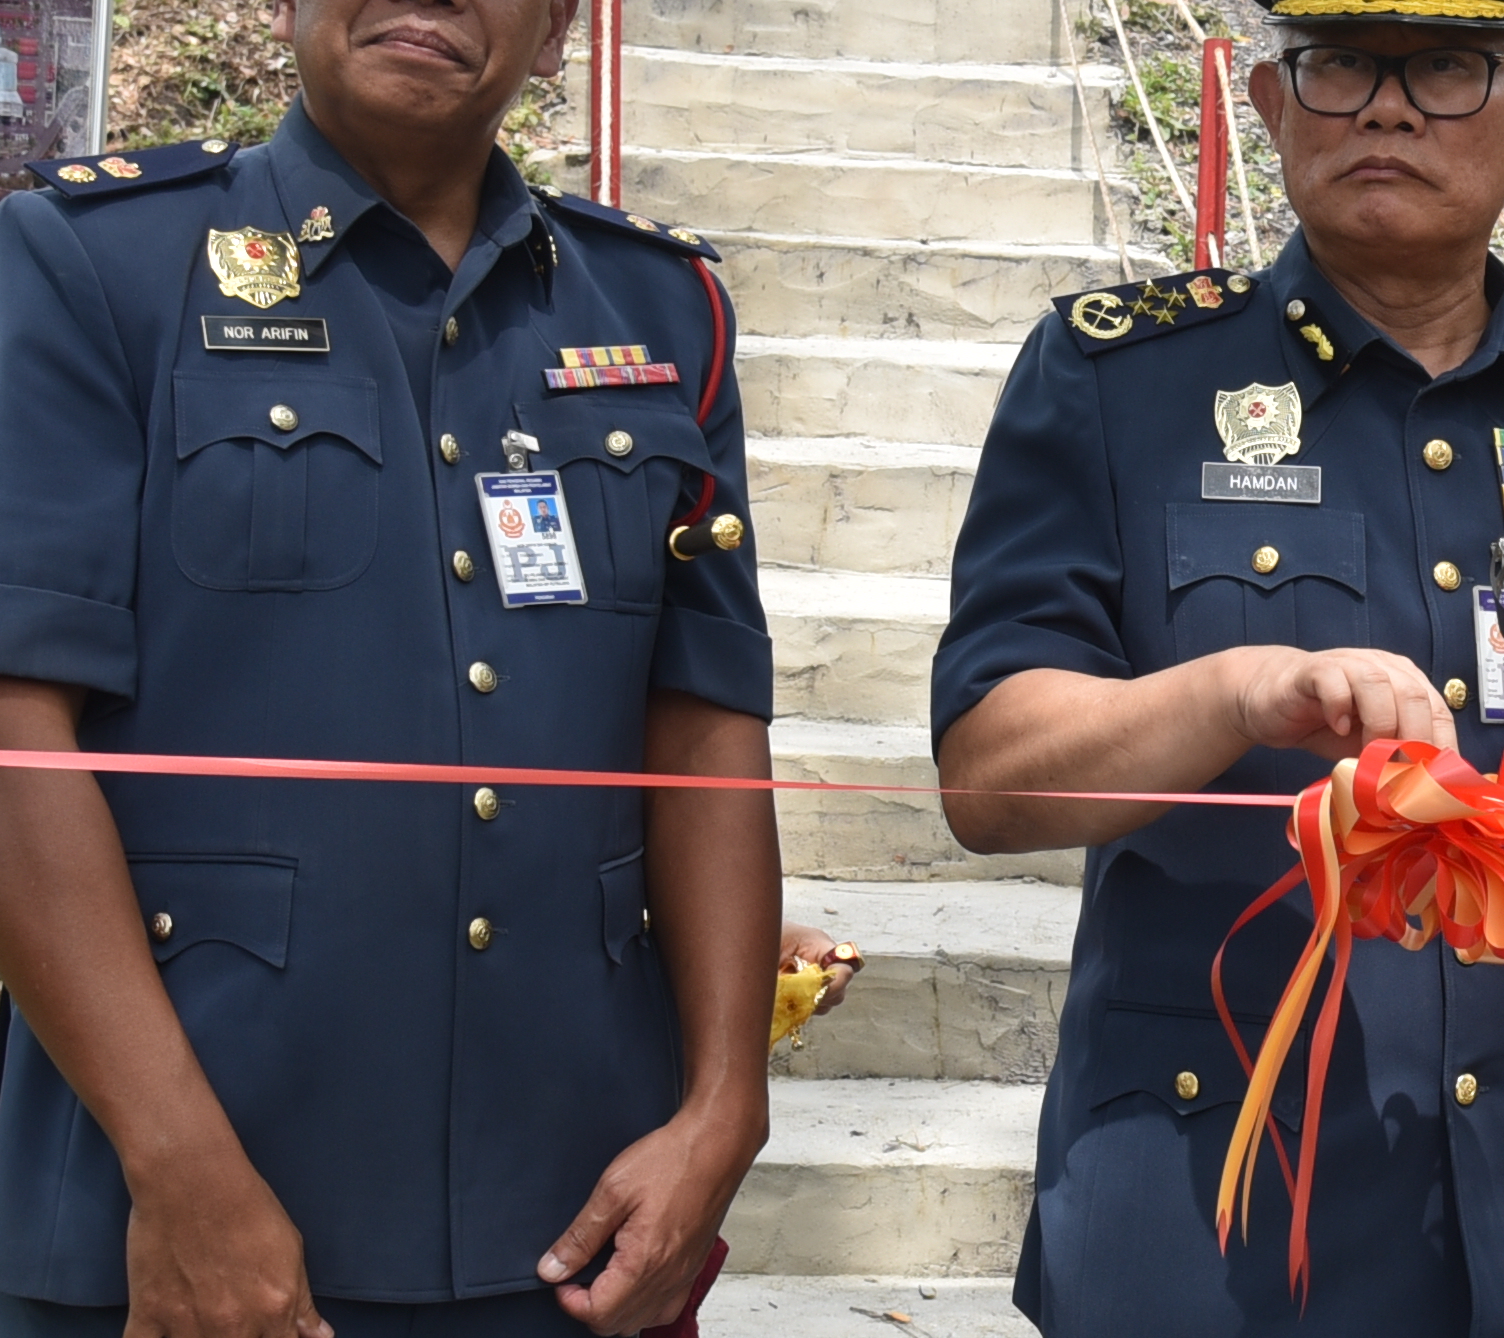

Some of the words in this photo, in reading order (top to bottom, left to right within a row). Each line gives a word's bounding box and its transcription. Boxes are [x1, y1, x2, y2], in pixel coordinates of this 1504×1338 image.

[223, 326, 254, 339] NOR
[261, 327, 309, 340] ARIFIN
[1229, 474, 1298, 490] HAMDAN
